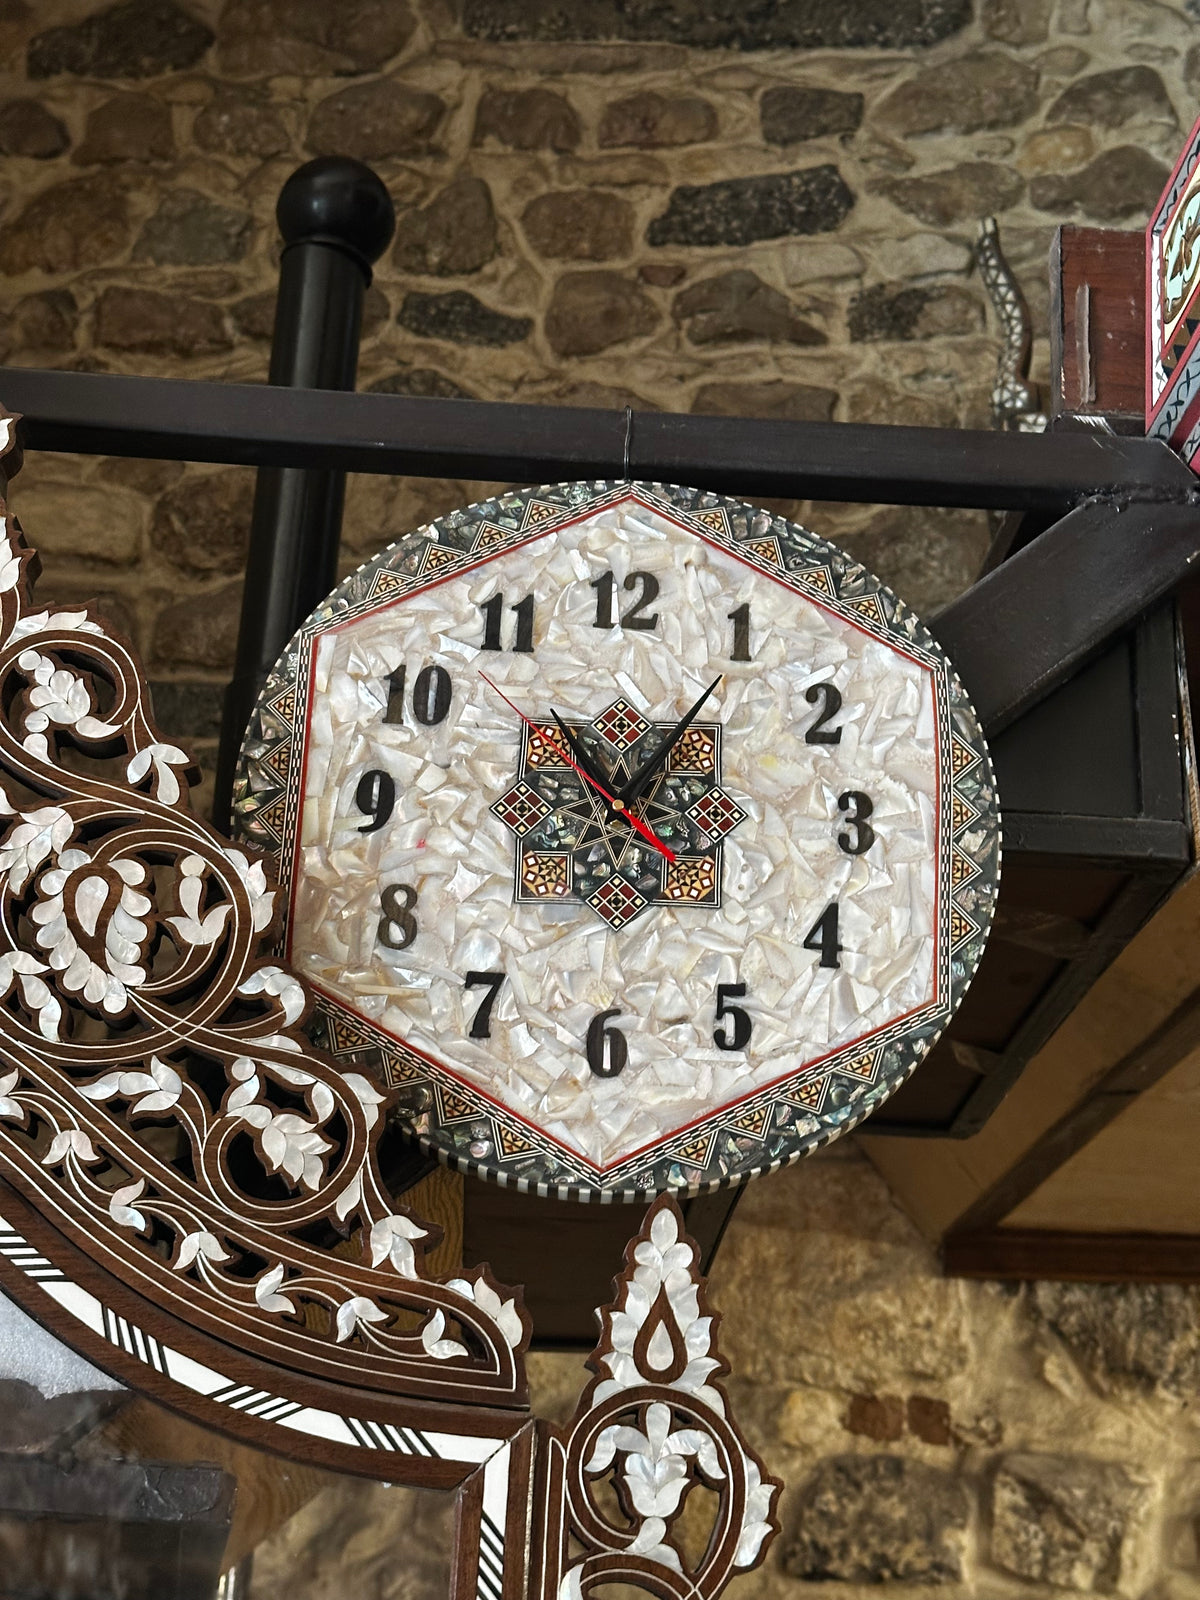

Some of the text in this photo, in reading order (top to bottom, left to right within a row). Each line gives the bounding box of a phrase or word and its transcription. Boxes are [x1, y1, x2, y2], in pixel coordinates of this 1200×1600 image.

[481, 592, 535, 653] 11
[591, 571, 660, 630] 12
[728, 604, 752, 662] 1
[382, 665, 453, 726] 10
[805, 684, 843, 745] 2
[356, 769, 396, 834] 9
[838, 791, 875, 856] 3
[378, 885, 418, 951] 8
[804, 903, 843, 969] 4
[465, 971, 506, 1040] 7
[714, 983, 752, 1052] 5
[587, 1009, 628, 1077] 6
